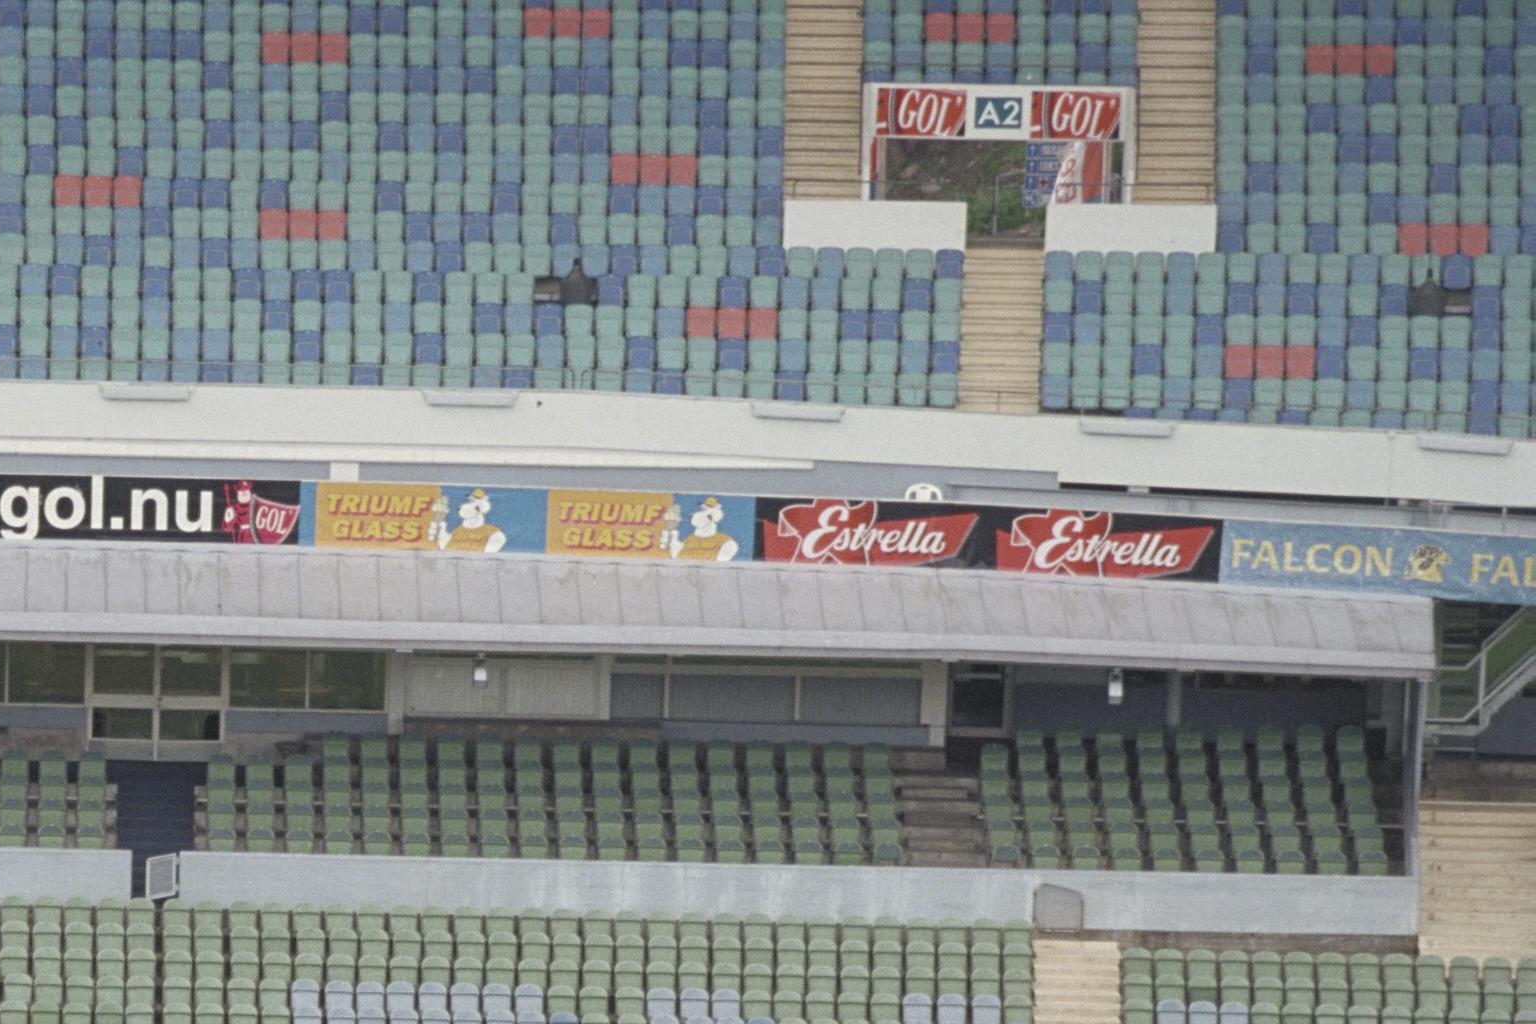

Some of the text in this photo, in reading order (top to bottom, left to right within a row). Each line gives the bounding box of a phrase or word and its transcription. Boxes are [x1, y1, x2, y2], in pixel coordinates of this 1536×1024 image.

[978, 101, 1019, 126] A2
[0, 475, 214, 540] gol.nu
[328, 494, 432, 516] TRIUMF
[559, 502, 664, 525] TRIUMF
[332, 519, 422, 542] GLASS
[562, 528, 653, 550] GLASS
[801, 503, 946, 559] Estrella
[1034, 515, 1181, 570] Estrella
[1231, 539, 1393, 577] FALCON
